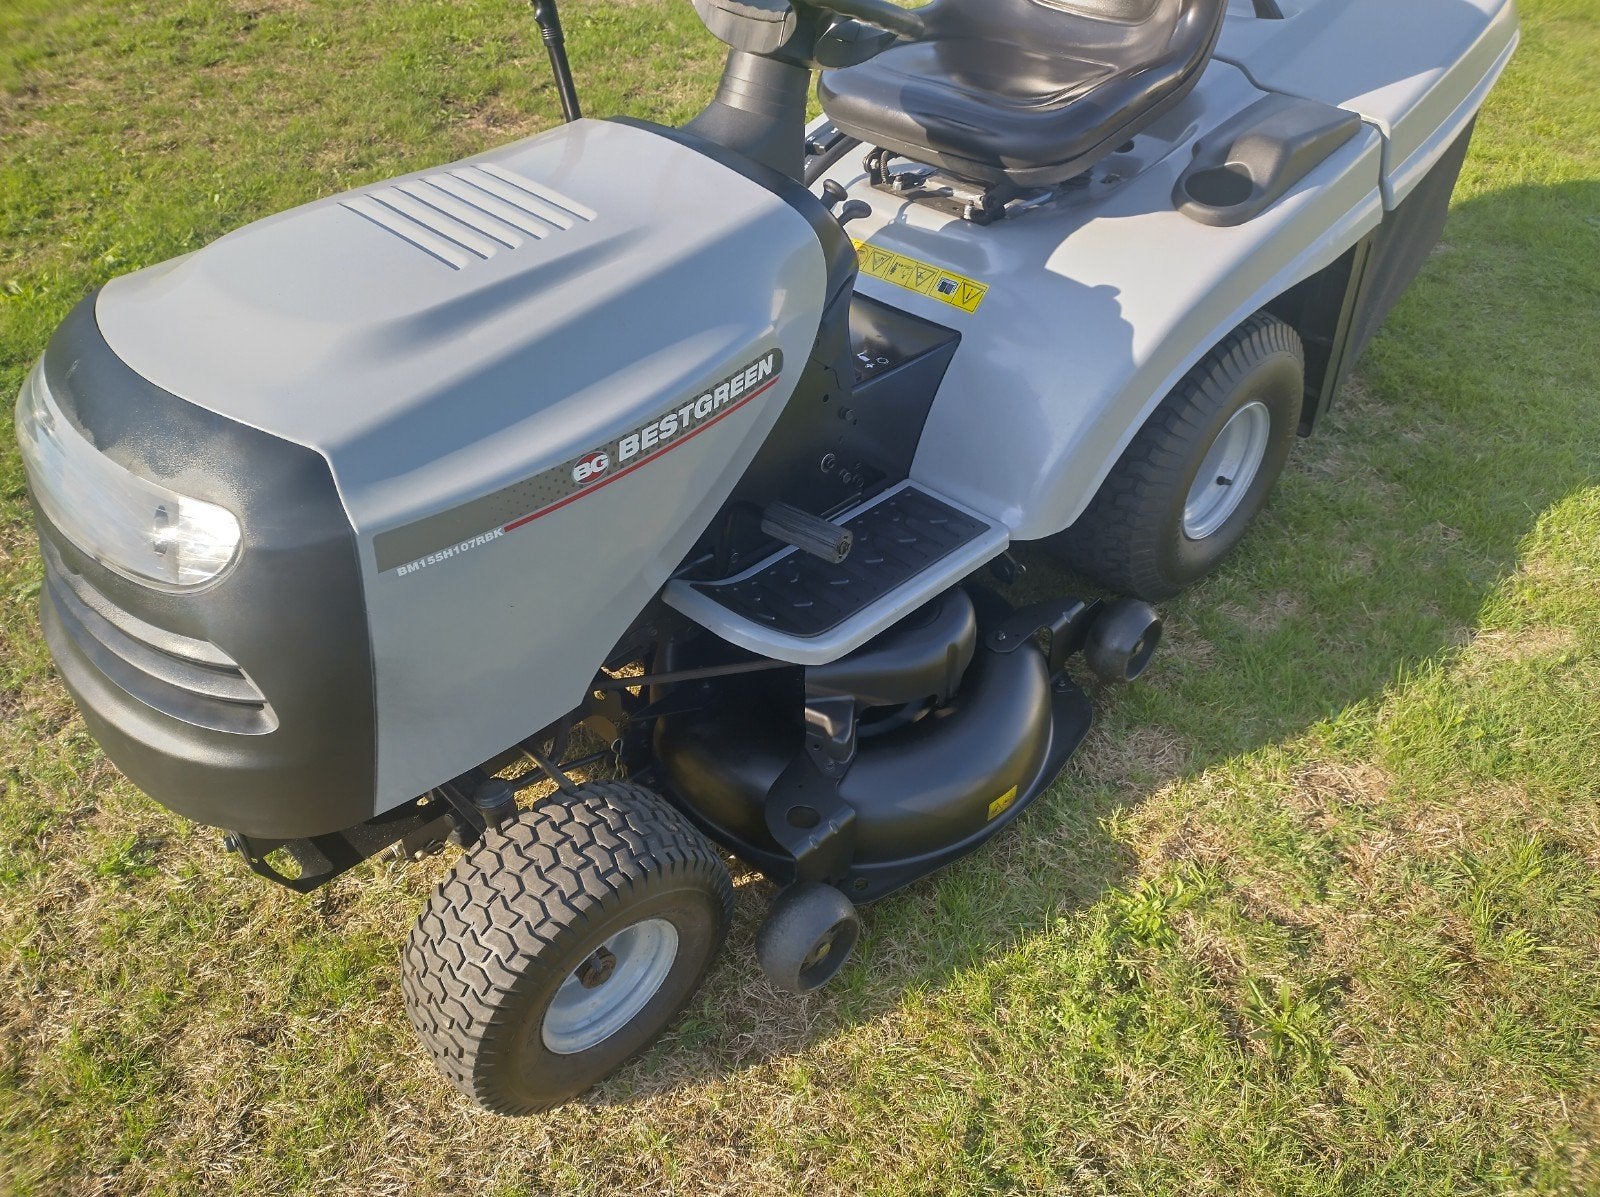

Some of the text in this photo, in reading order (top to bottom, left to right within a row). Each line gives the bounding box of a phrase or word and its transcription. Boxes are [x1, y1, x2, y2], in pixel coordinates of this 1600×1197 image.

[573, 354, 774, 483] BG BESTGREEN
[396, 527, 504, 577] BM155H107RBK
